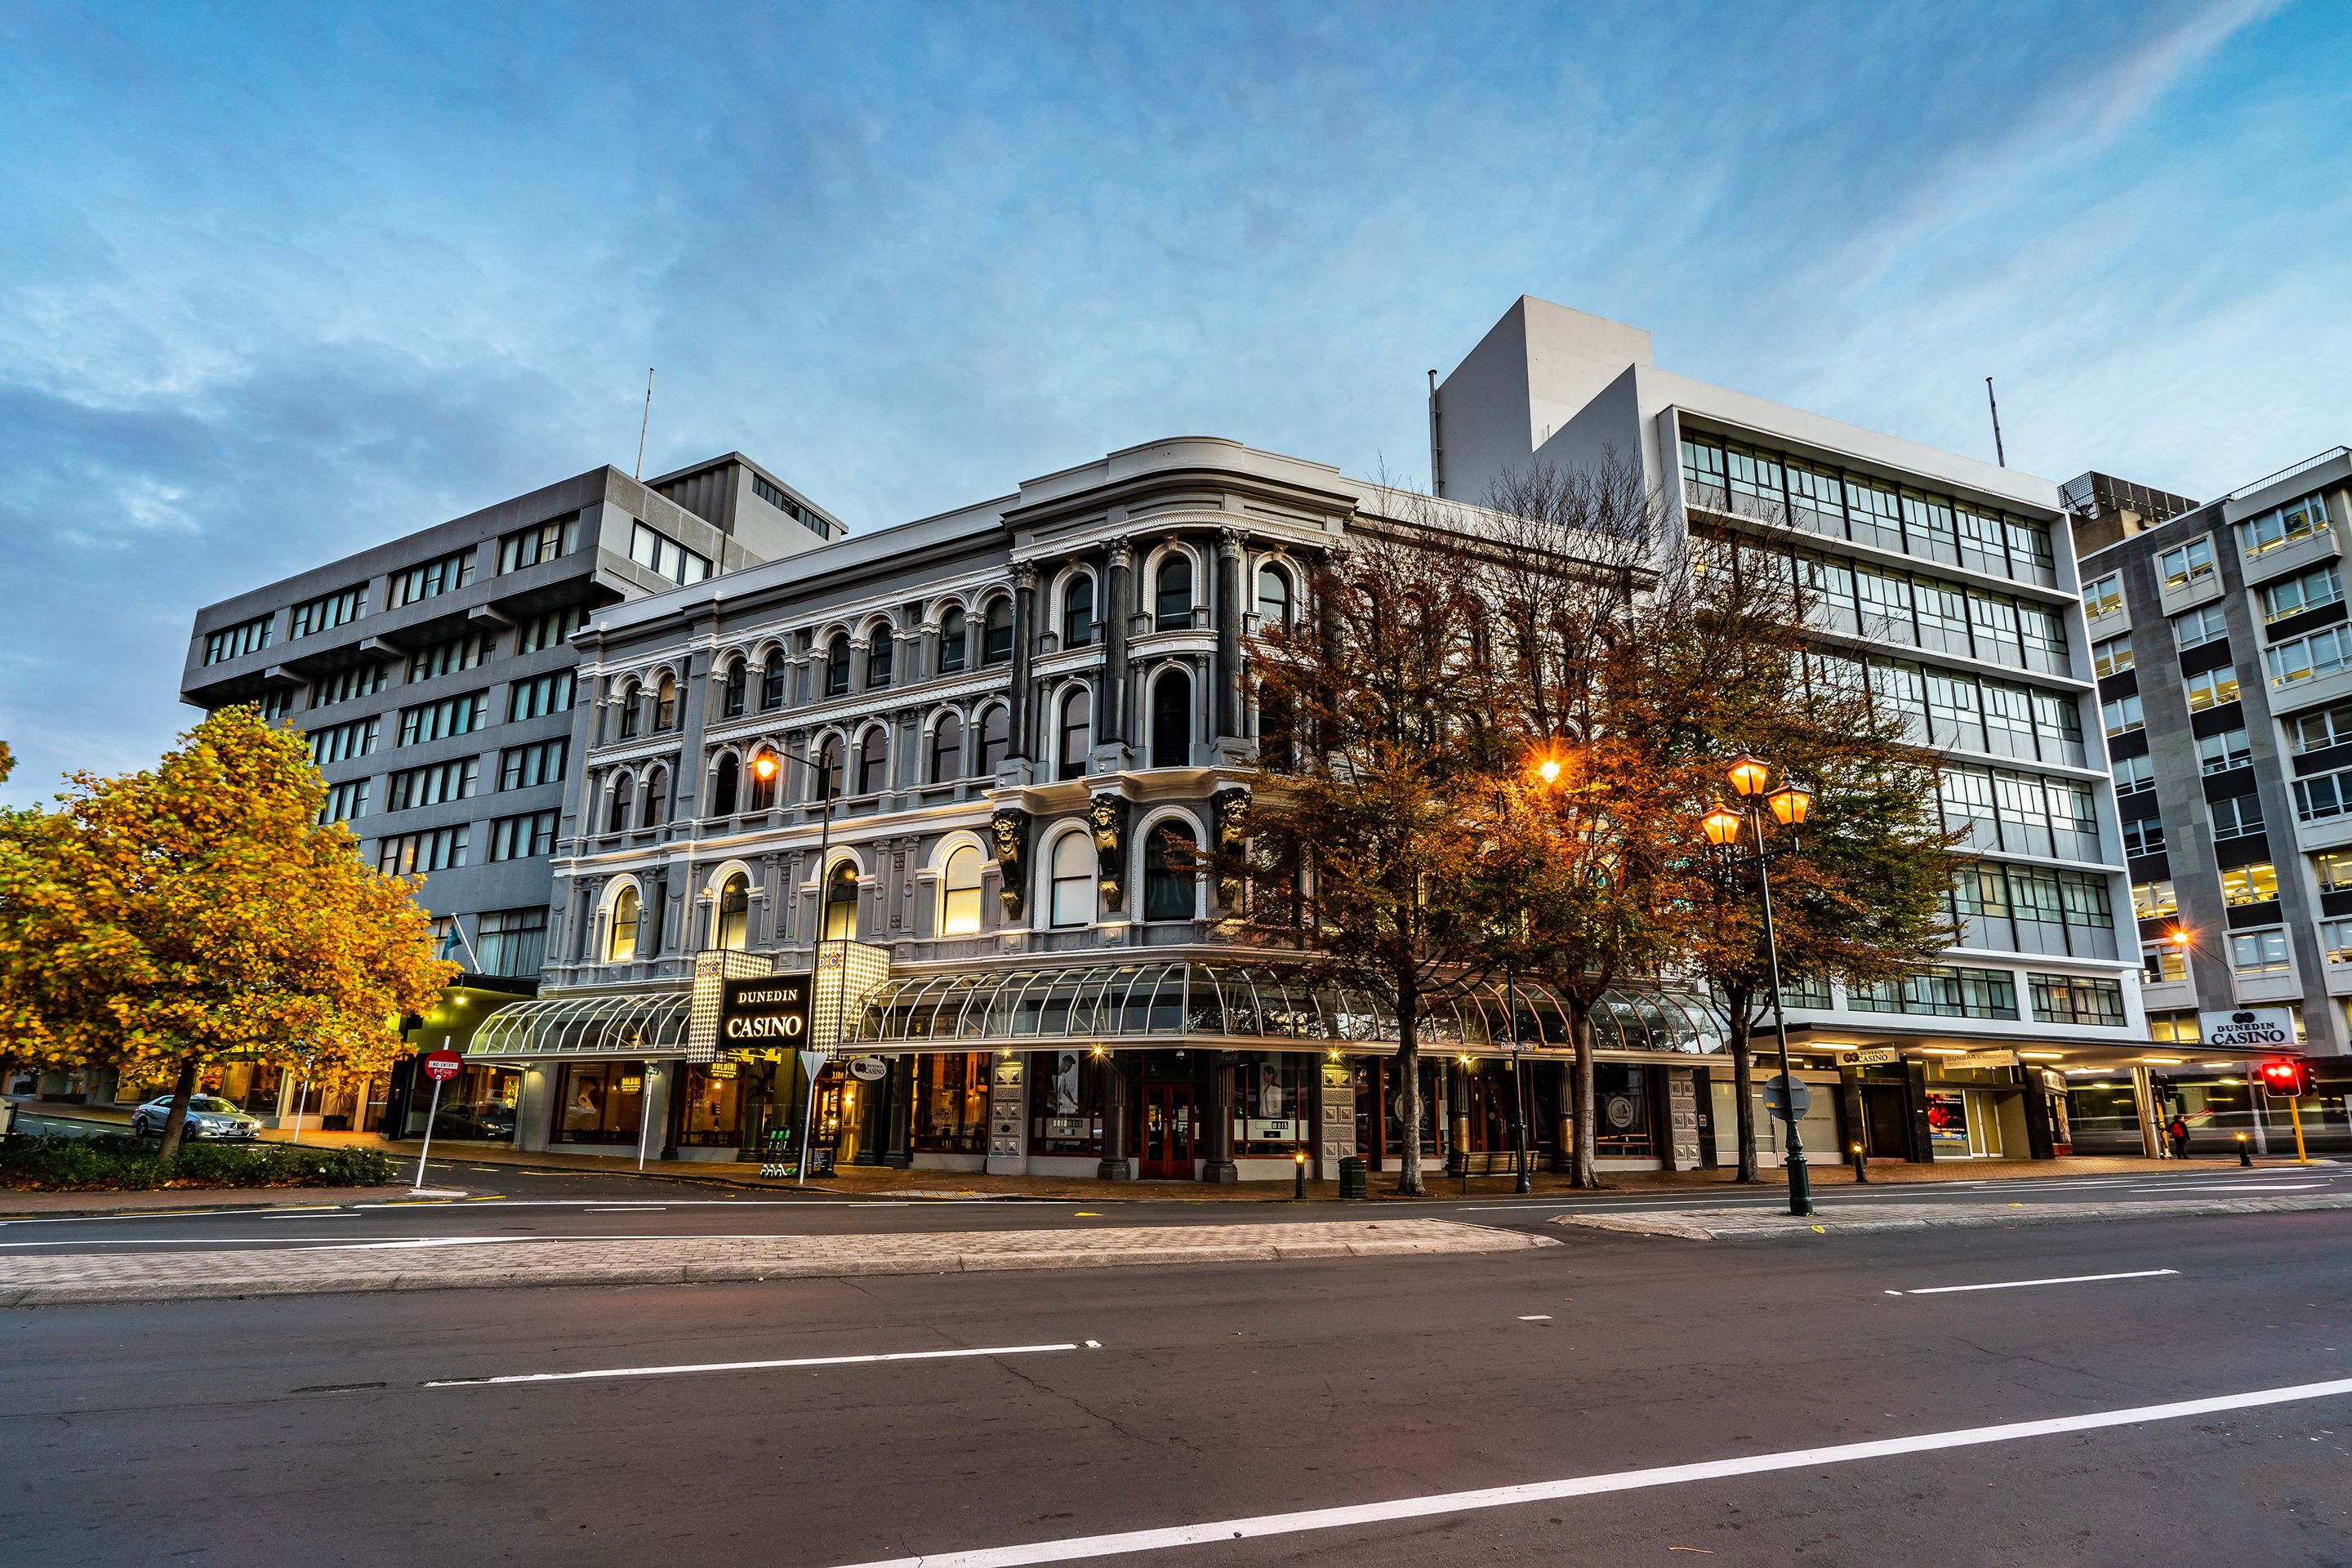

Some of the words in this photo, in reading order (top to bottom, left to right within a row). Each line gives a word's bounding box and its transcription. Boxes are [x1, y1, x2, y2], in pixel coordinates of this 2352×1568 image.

[738, 989, 798, 1004] DUNEDIN
[728, 1015, 802, 1038] CASINO
[2216, 1022, 2274, 1032] DUNEDIN
[2212, 1030, 2285, 1045] CASINO
[1501, 1042, 1524, 1051] Princes
[1859, 1054, 1888, 1062] CASINO
